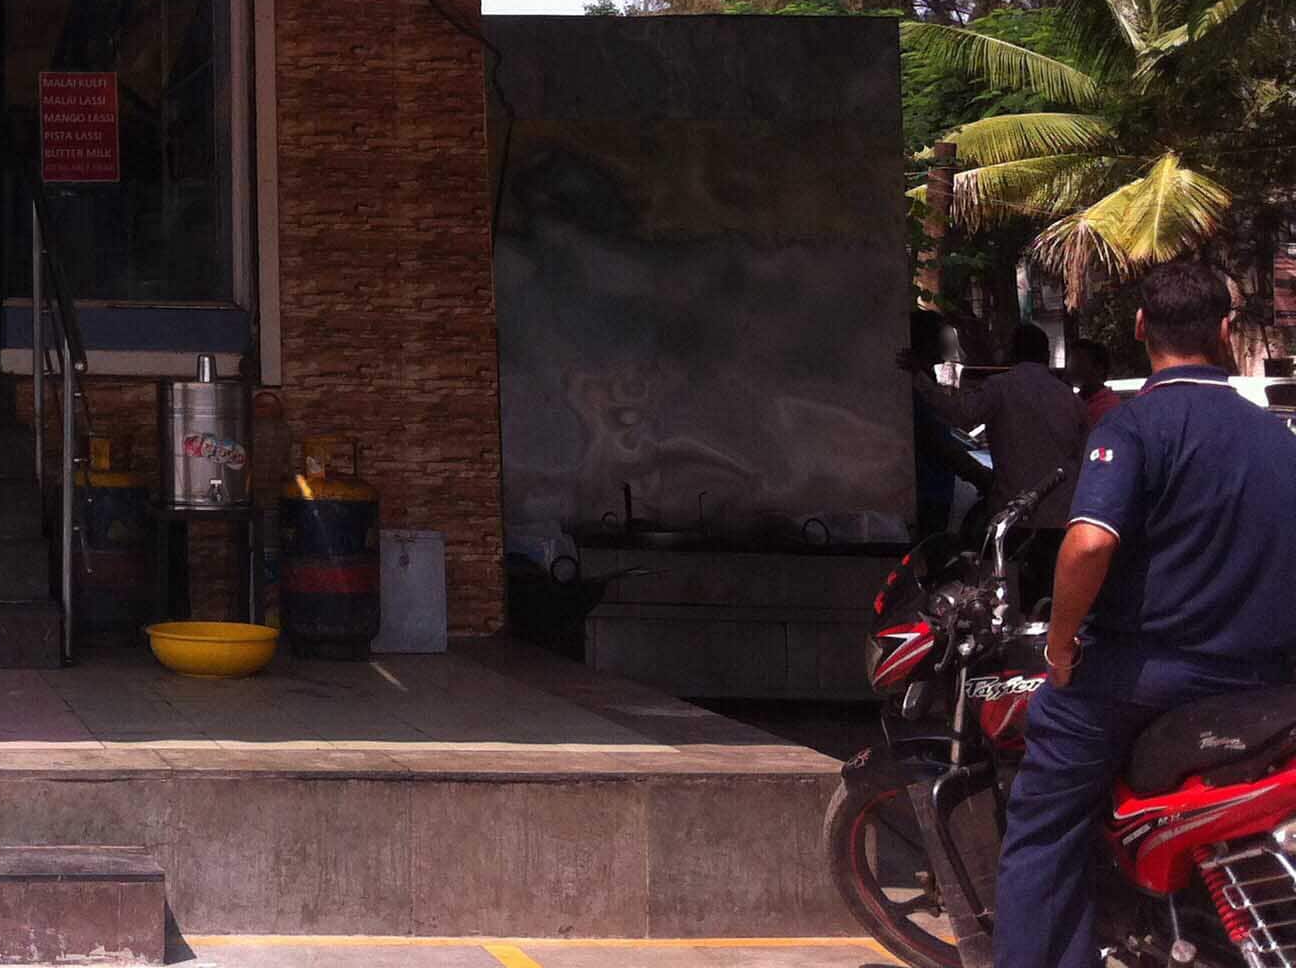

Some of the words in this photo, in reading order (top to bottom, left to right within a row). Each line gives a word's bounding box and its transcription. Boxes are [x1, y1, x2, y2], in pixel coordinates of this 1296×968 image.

[43, 79, 77, 88] MALAI
[44, 95, 76, 105] MALAI
[79, 95, 106, 105] LASSI
[44, 113, 85, 123] MANGO
[87, 113, 115, 123] LASSI
[44, 131, 73, 141] PISTA
[75, 131, 103, 141] LASSI
[86, 148, 112, 159] MILK
